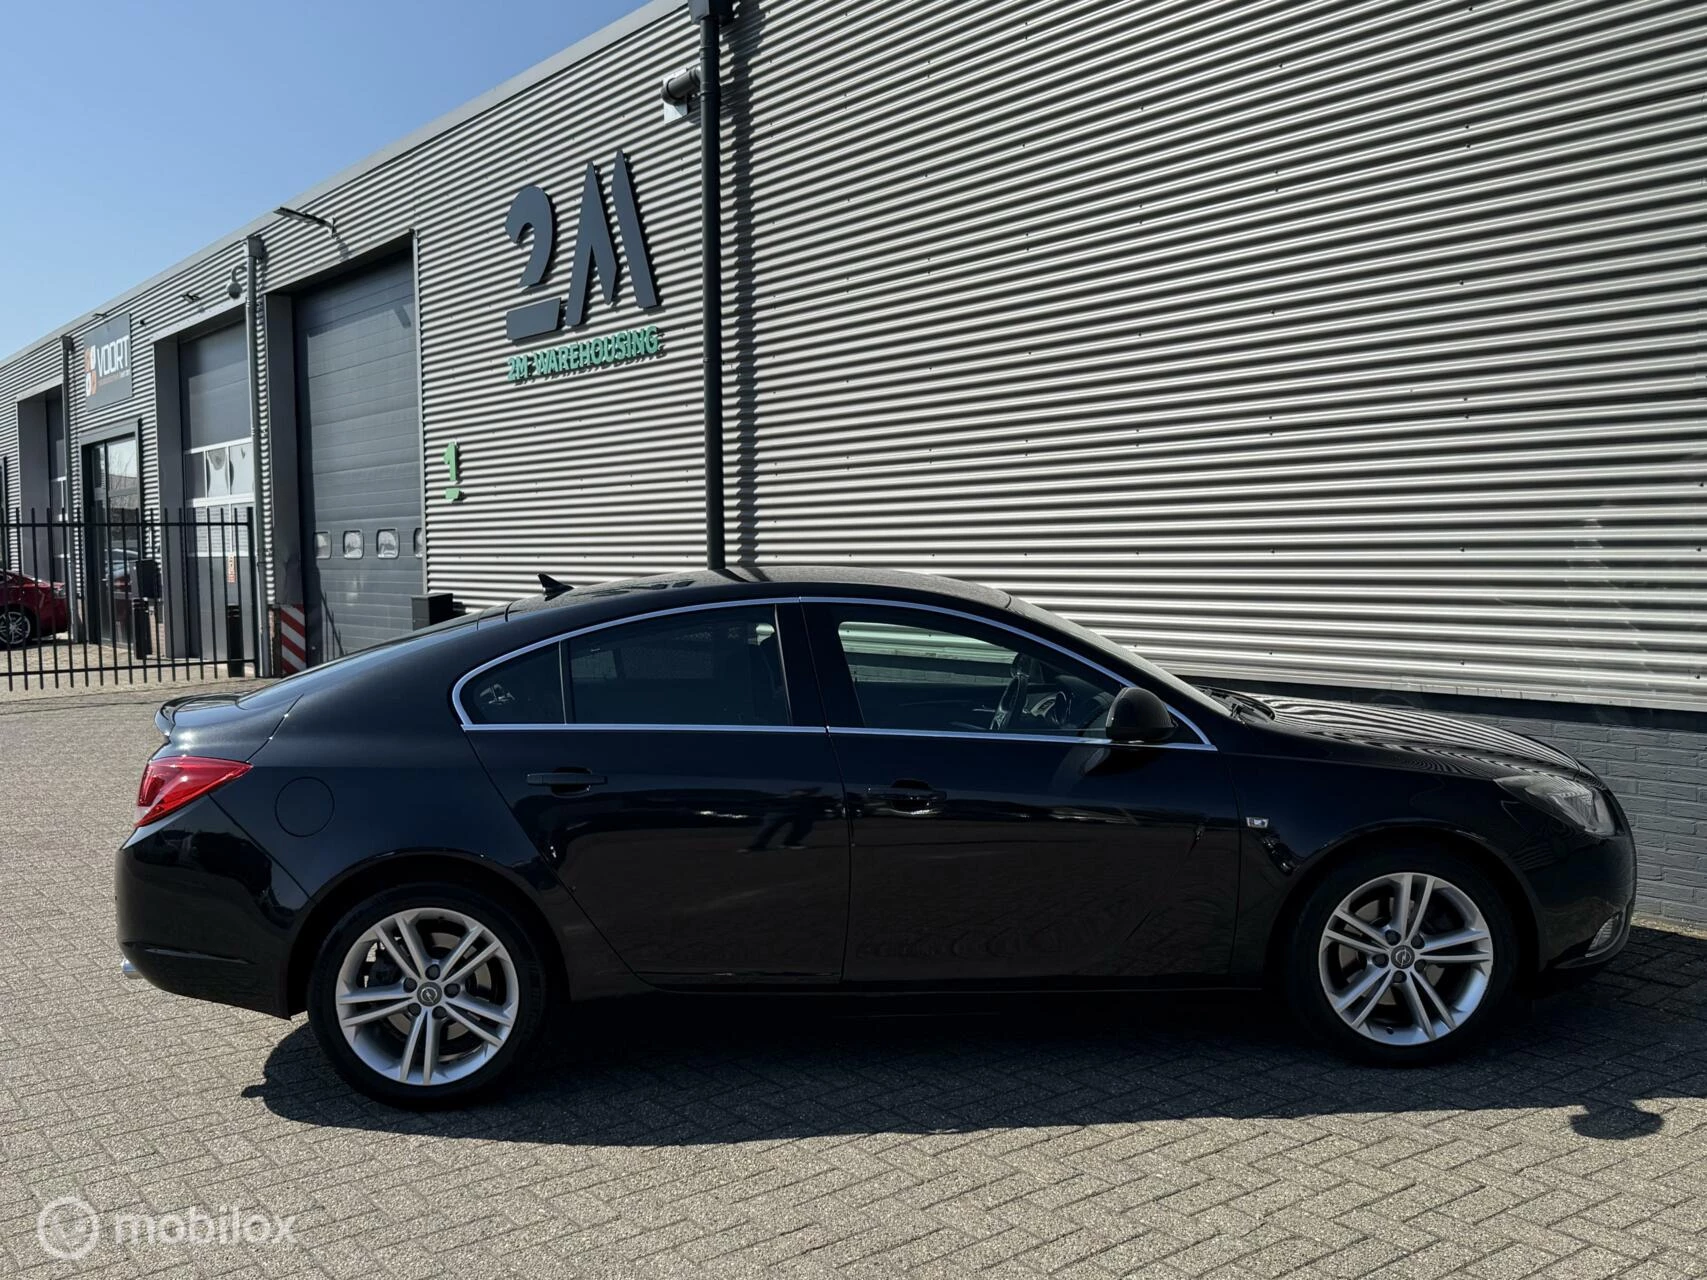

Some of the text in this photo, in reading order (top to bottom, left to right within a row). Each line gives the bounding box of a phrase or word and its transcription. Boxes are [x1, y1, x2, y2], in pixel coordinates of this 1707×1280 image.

[505, 151, 658, 340] 2M
[97, 335, 130, 377] VOORT
[507, 326, 659, 381] 2M WAREHOUSING
